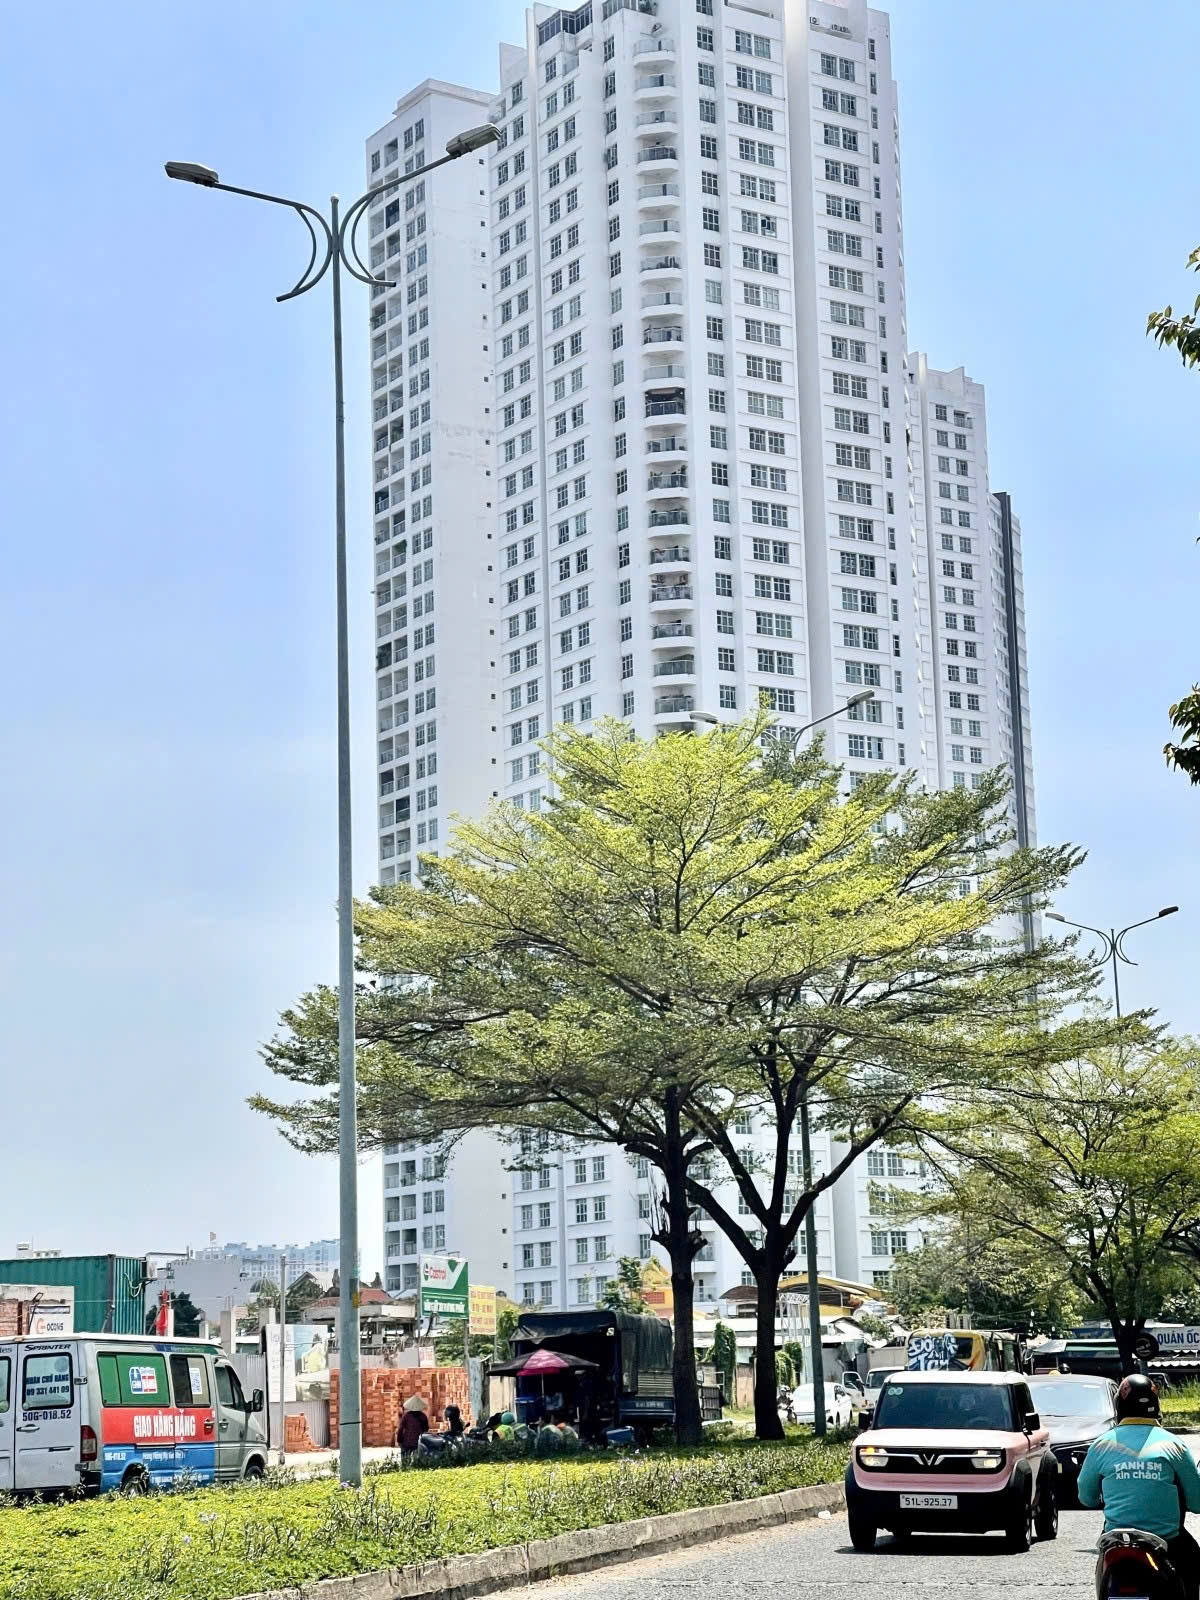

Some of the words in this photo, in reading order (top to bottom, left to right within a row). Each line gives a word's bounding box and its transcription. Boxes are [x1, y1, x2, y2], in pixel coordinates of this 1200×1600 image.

[22, 1409, 71, 1422] 50G-018.52
[133, 1415, 153, 1438] GIAO
[153, 1409, 174, 1437] HÀNG
[174, 1409, 196, 1441] NẶNG
[905, 1497, 952, 1506] 51L-925.37
